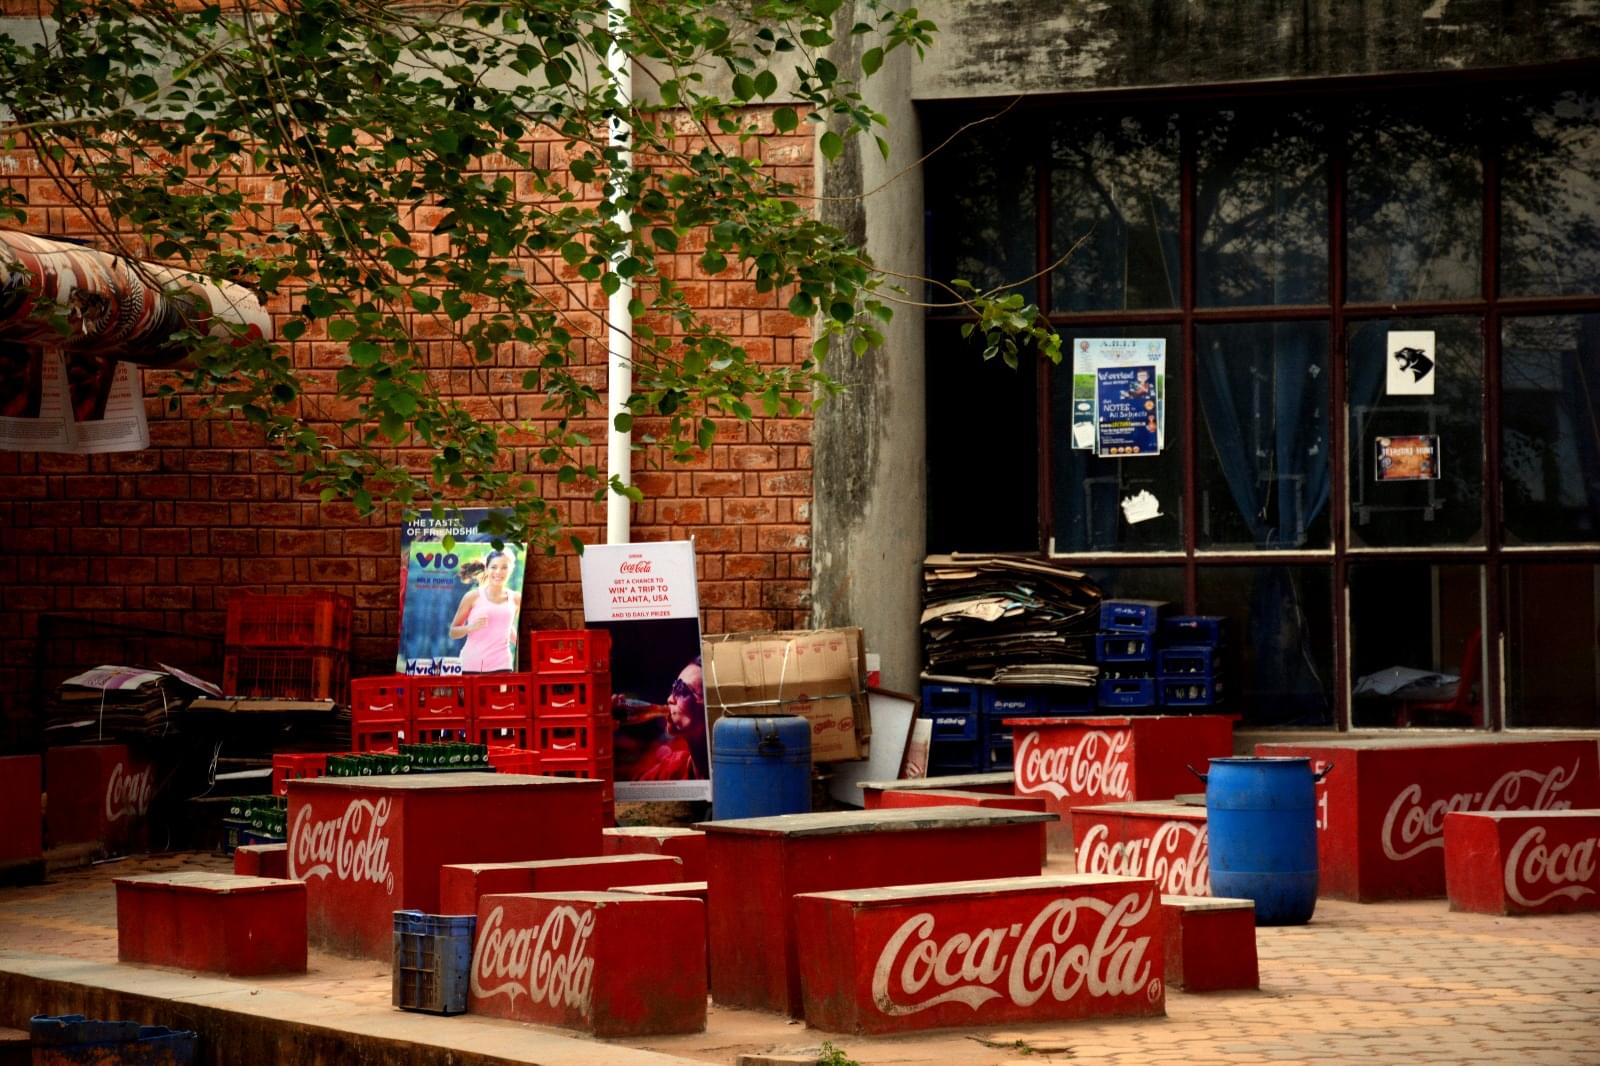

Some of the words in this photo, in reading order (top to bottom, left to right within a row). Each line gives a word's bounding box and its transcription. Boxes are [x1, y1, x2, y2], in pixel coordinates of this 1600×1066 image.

[1103, 403, 1131, 412] NOTES
[406, 528, 421, 536] OF
[638, 585, 655, 593] TRIP
[612, 595, 651, 604] ATLANTA,
[652, 594, 668, 602] USA
[872, 889, 1153, 1016] Coca-Cola
